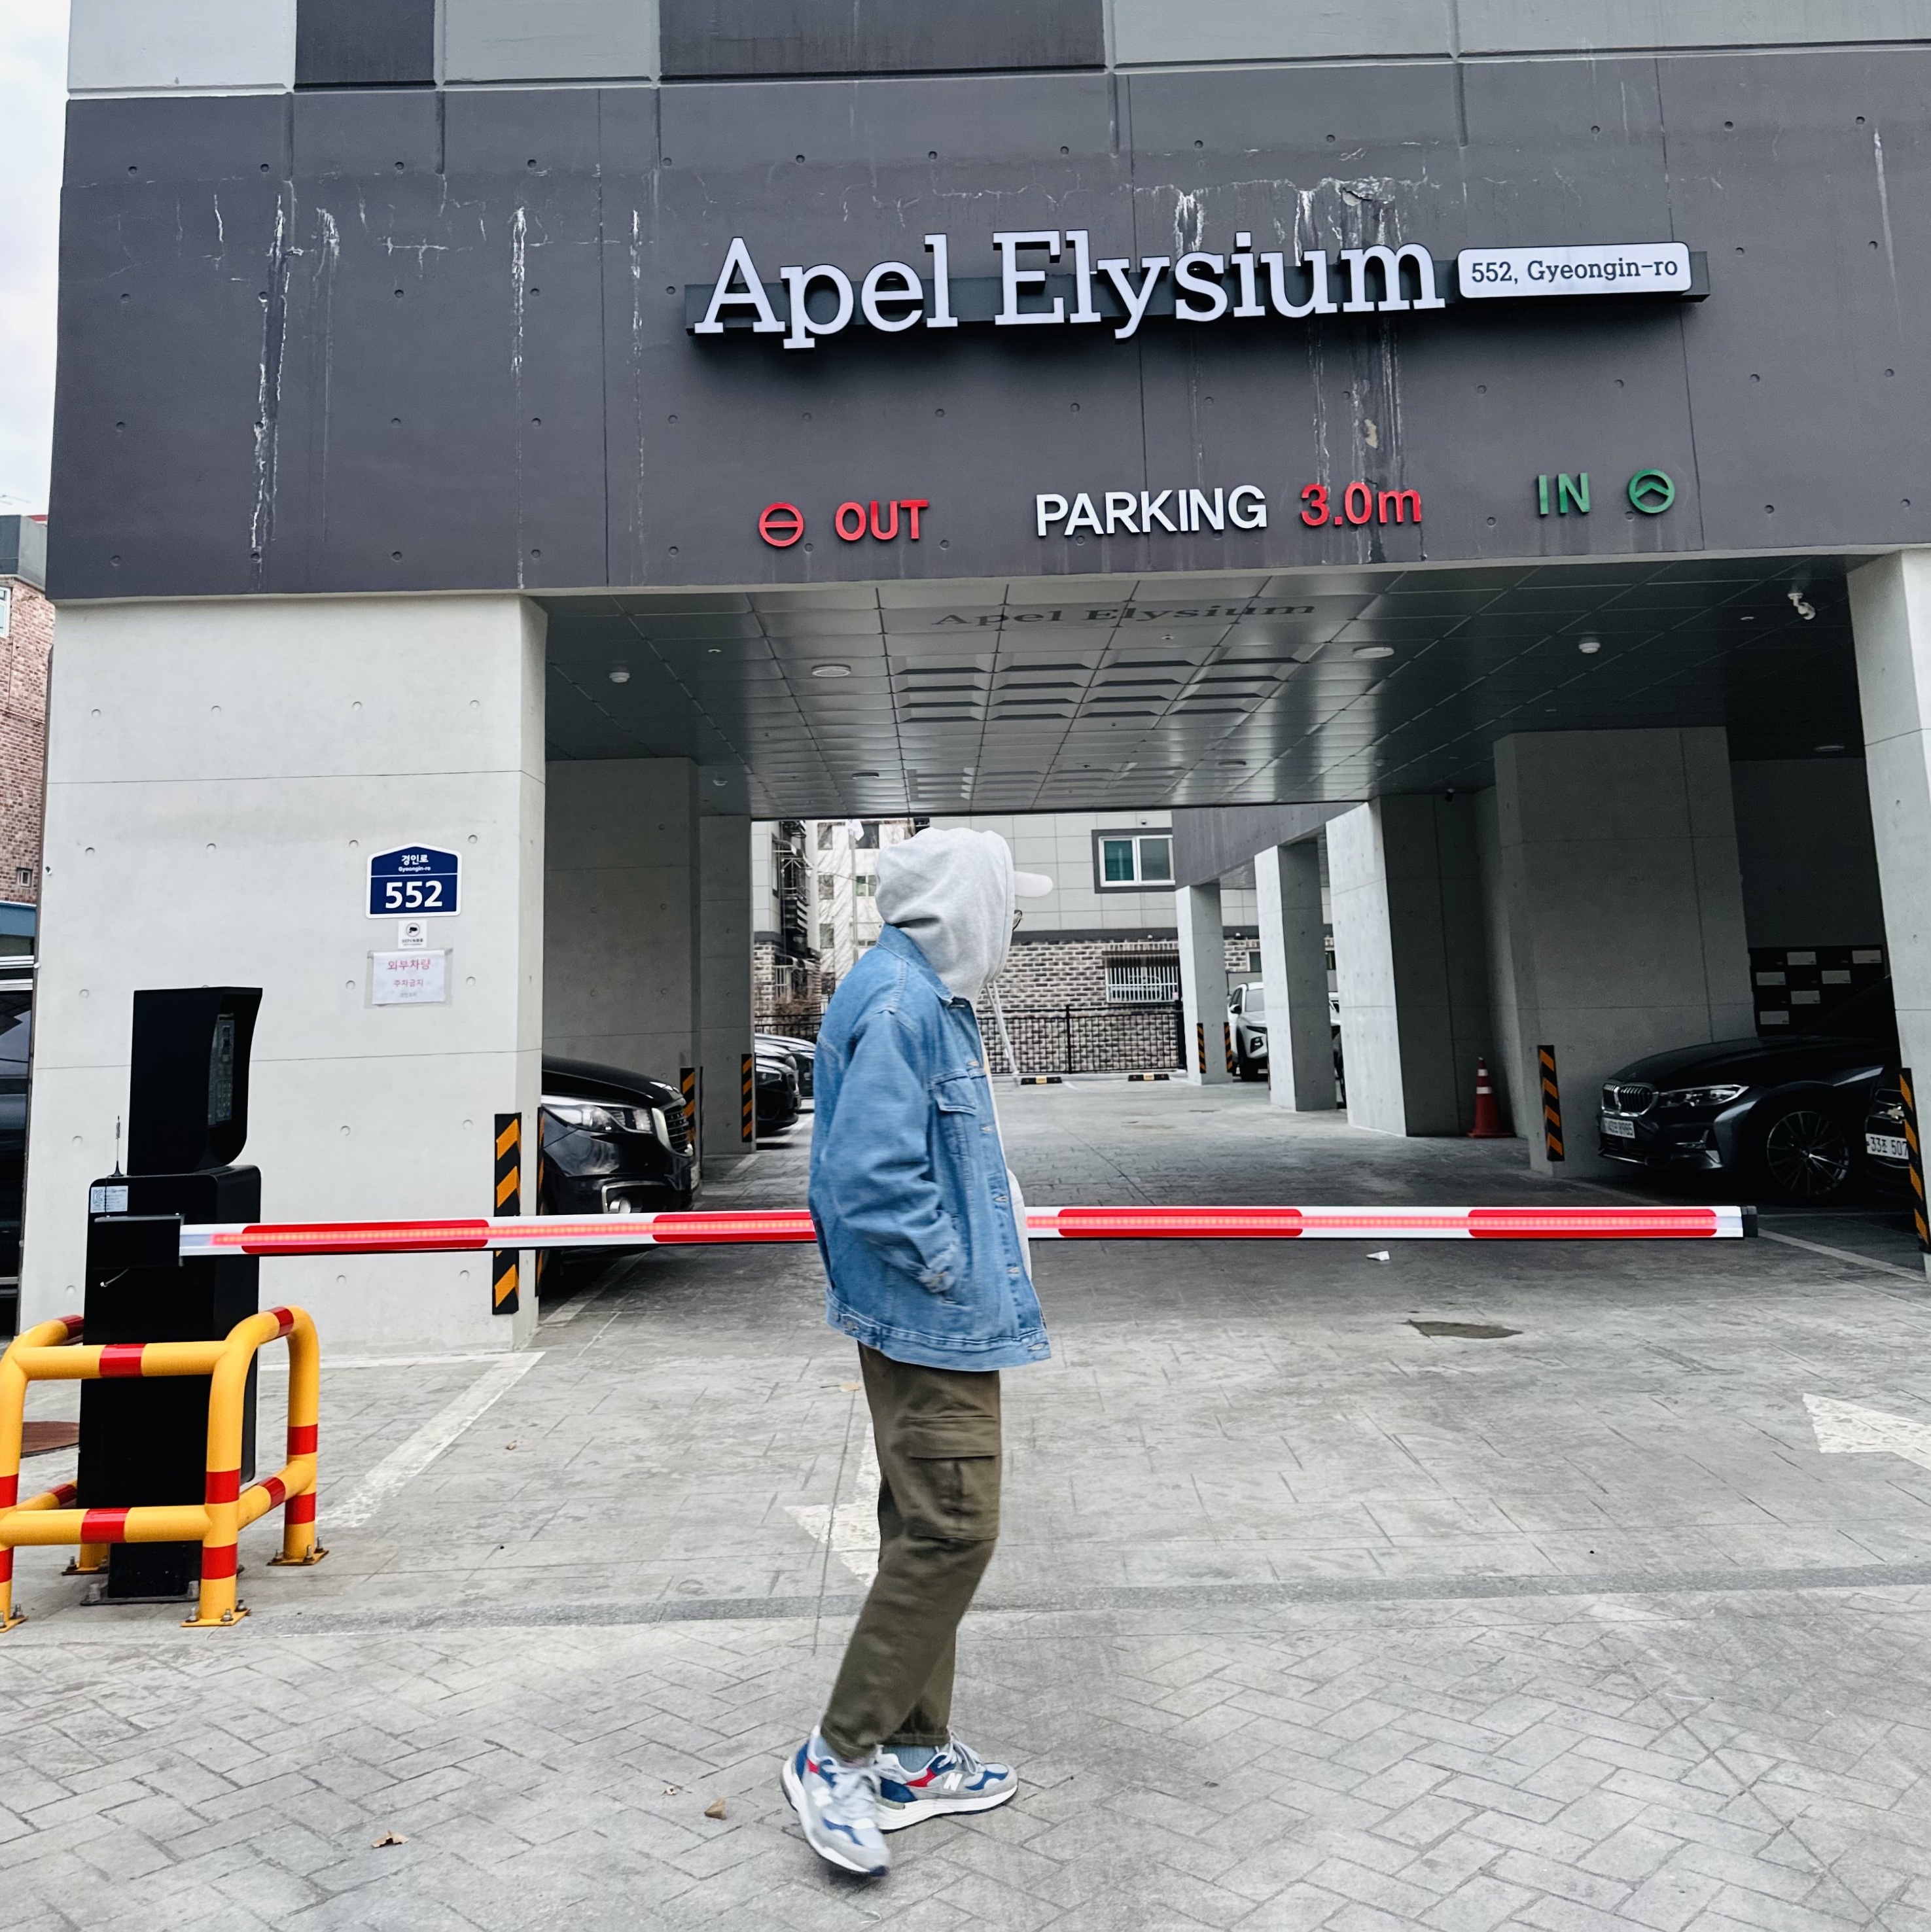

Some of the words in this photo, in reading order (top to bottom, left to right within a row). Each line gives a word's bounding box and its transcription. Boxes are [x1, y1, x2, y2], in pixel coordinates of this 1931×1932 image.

[1471, 261, 1519, 285] 552,
[1527, 257, 1678, 283] Gyeongin-ro
[694, 233, 958, 349] Apel
[993, 230, 1445, 340] Elysium
[1538, 472, 1591, 515] IN
[835, 499, 929, 541] OUT
[1035, 484, 1267, 536] PARKING
[1300, 482, 1422, 527] 3.0m
[930, 609, 1063, 627] Apel
[1080, 603, 1316, 622] Elysium
[401, 854, 429, 866] 경인로
[385, 880, 443, 909] 552
[387, 958, 431, 971] 외부차량
